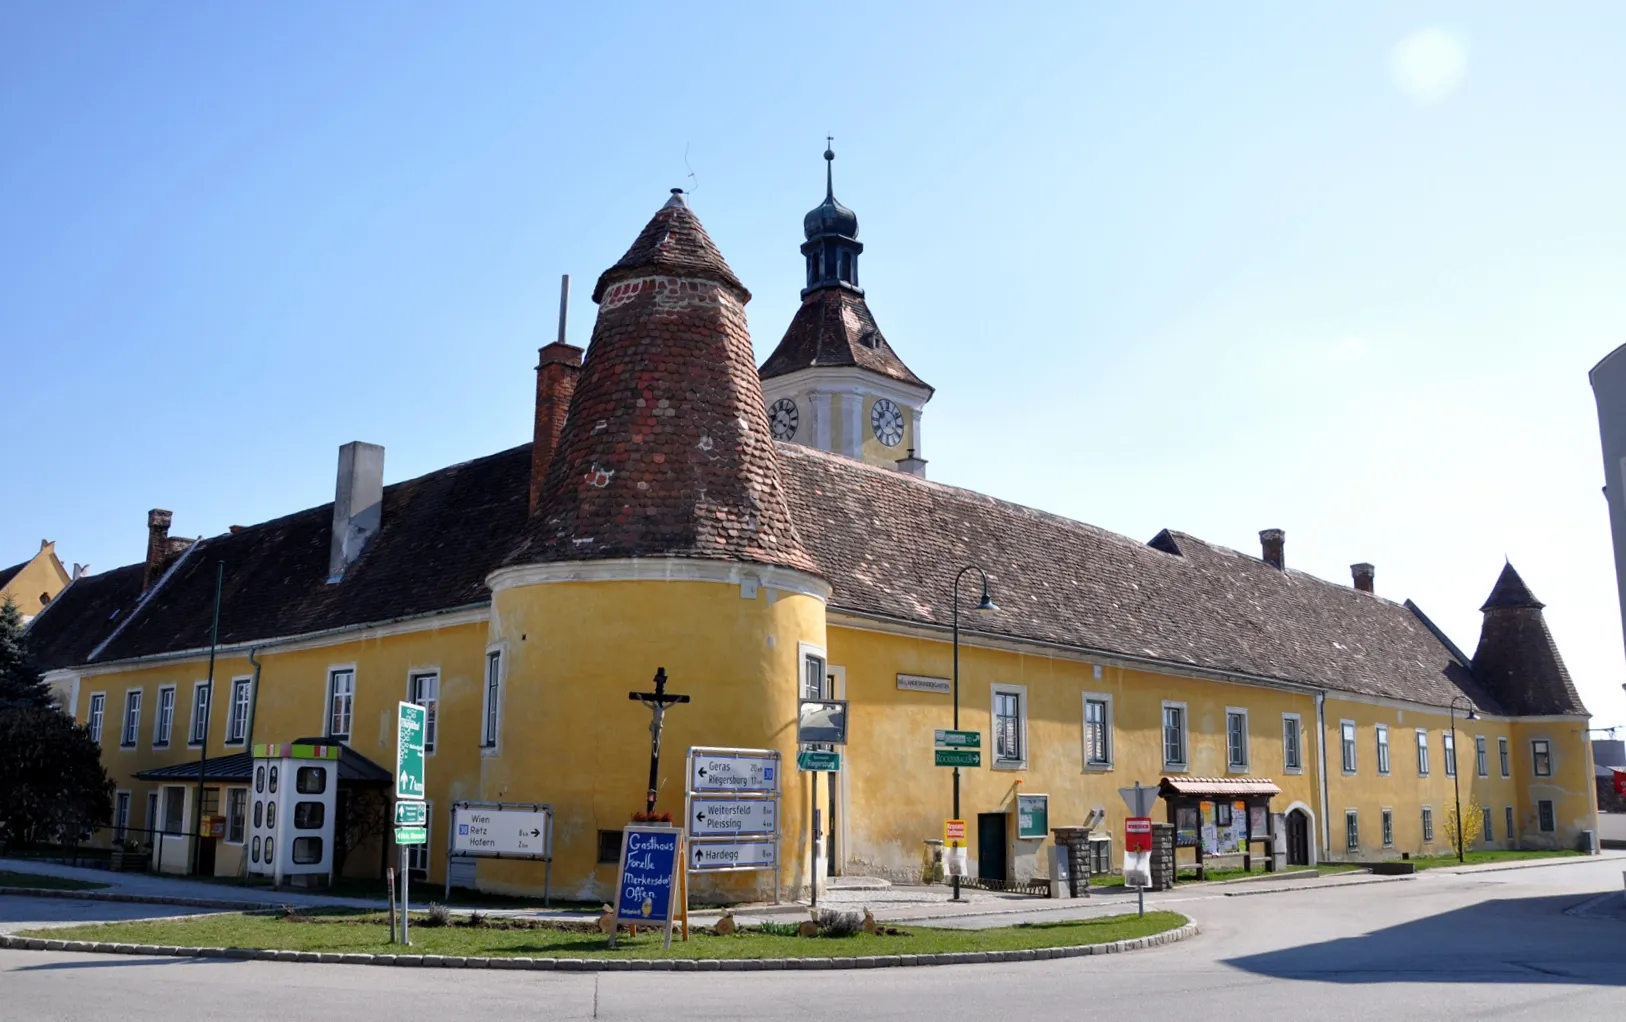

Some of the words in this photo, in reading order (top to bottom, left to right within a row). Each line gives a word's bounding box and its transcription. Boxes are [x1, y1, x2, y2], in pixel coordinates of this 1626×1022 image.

[708, 761, 731, 772] Geras
[750, 763, 757, 772] 20
[409, 775, 415, 790] 7
[708, 774, 748, 787] Riegersburg
[707, 805, 751, 815] Weitersfeld
[763, 806, 767, 815] 8
[471, 815, 490, 823] Wien
[707, 819, 742, 830] Pleissing
[470, 826, 488, 835] Retz
[469, 838, 495, 847] Hofern
[629, 833, 674, 851] Gasthaus
[625, 850, 655, 870] Forelle
[705, 849, 739, 861] Hardegg
[625, 886, 655, 902] Offen
